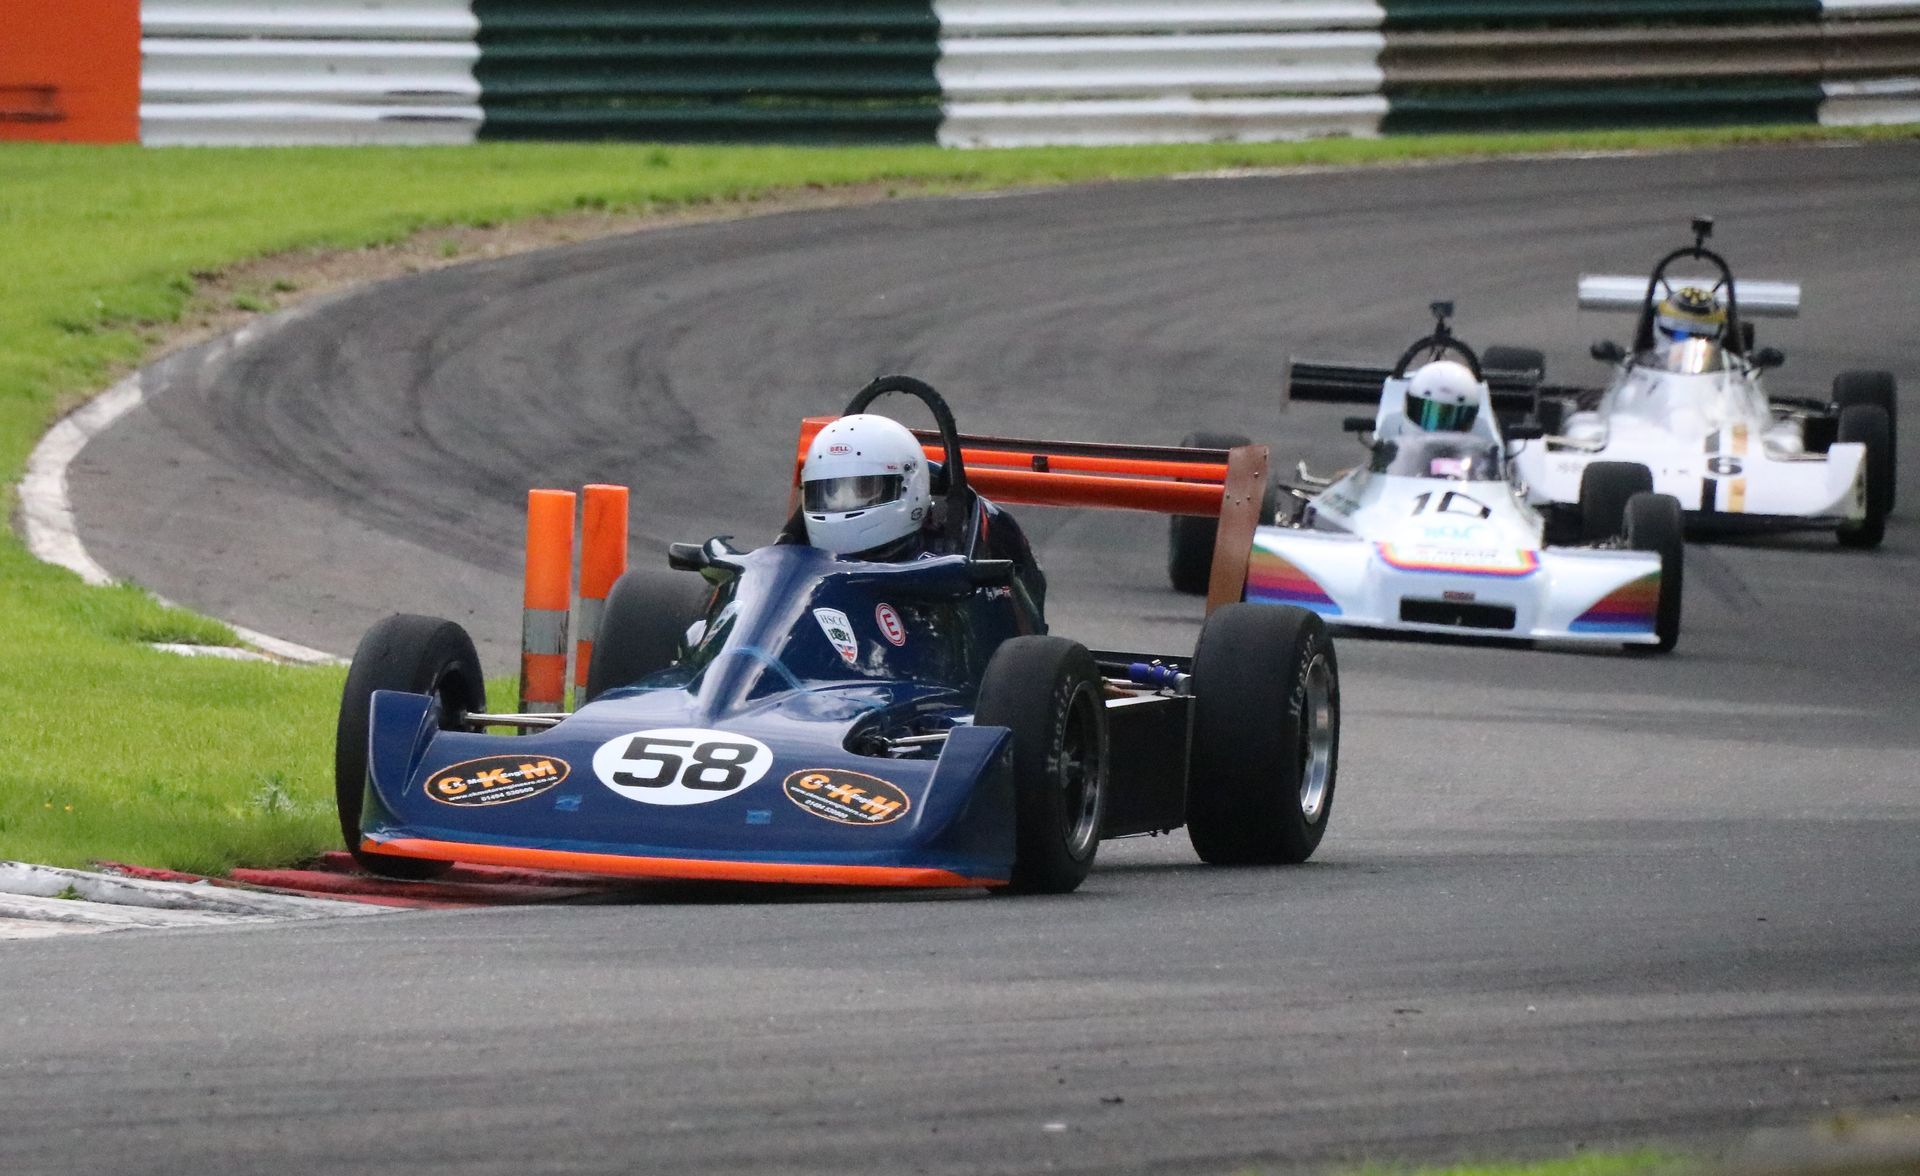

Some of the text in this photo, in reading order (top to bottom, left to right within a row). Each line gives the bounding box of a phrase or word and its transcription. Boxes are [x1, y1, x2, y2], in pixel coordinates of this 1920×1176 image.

[1707, 456, 1743, 475] 6
[1411, 491, 1492, 519] 10
[882, 613, 899, 636] E
[612, 736, 758, 791] 58
